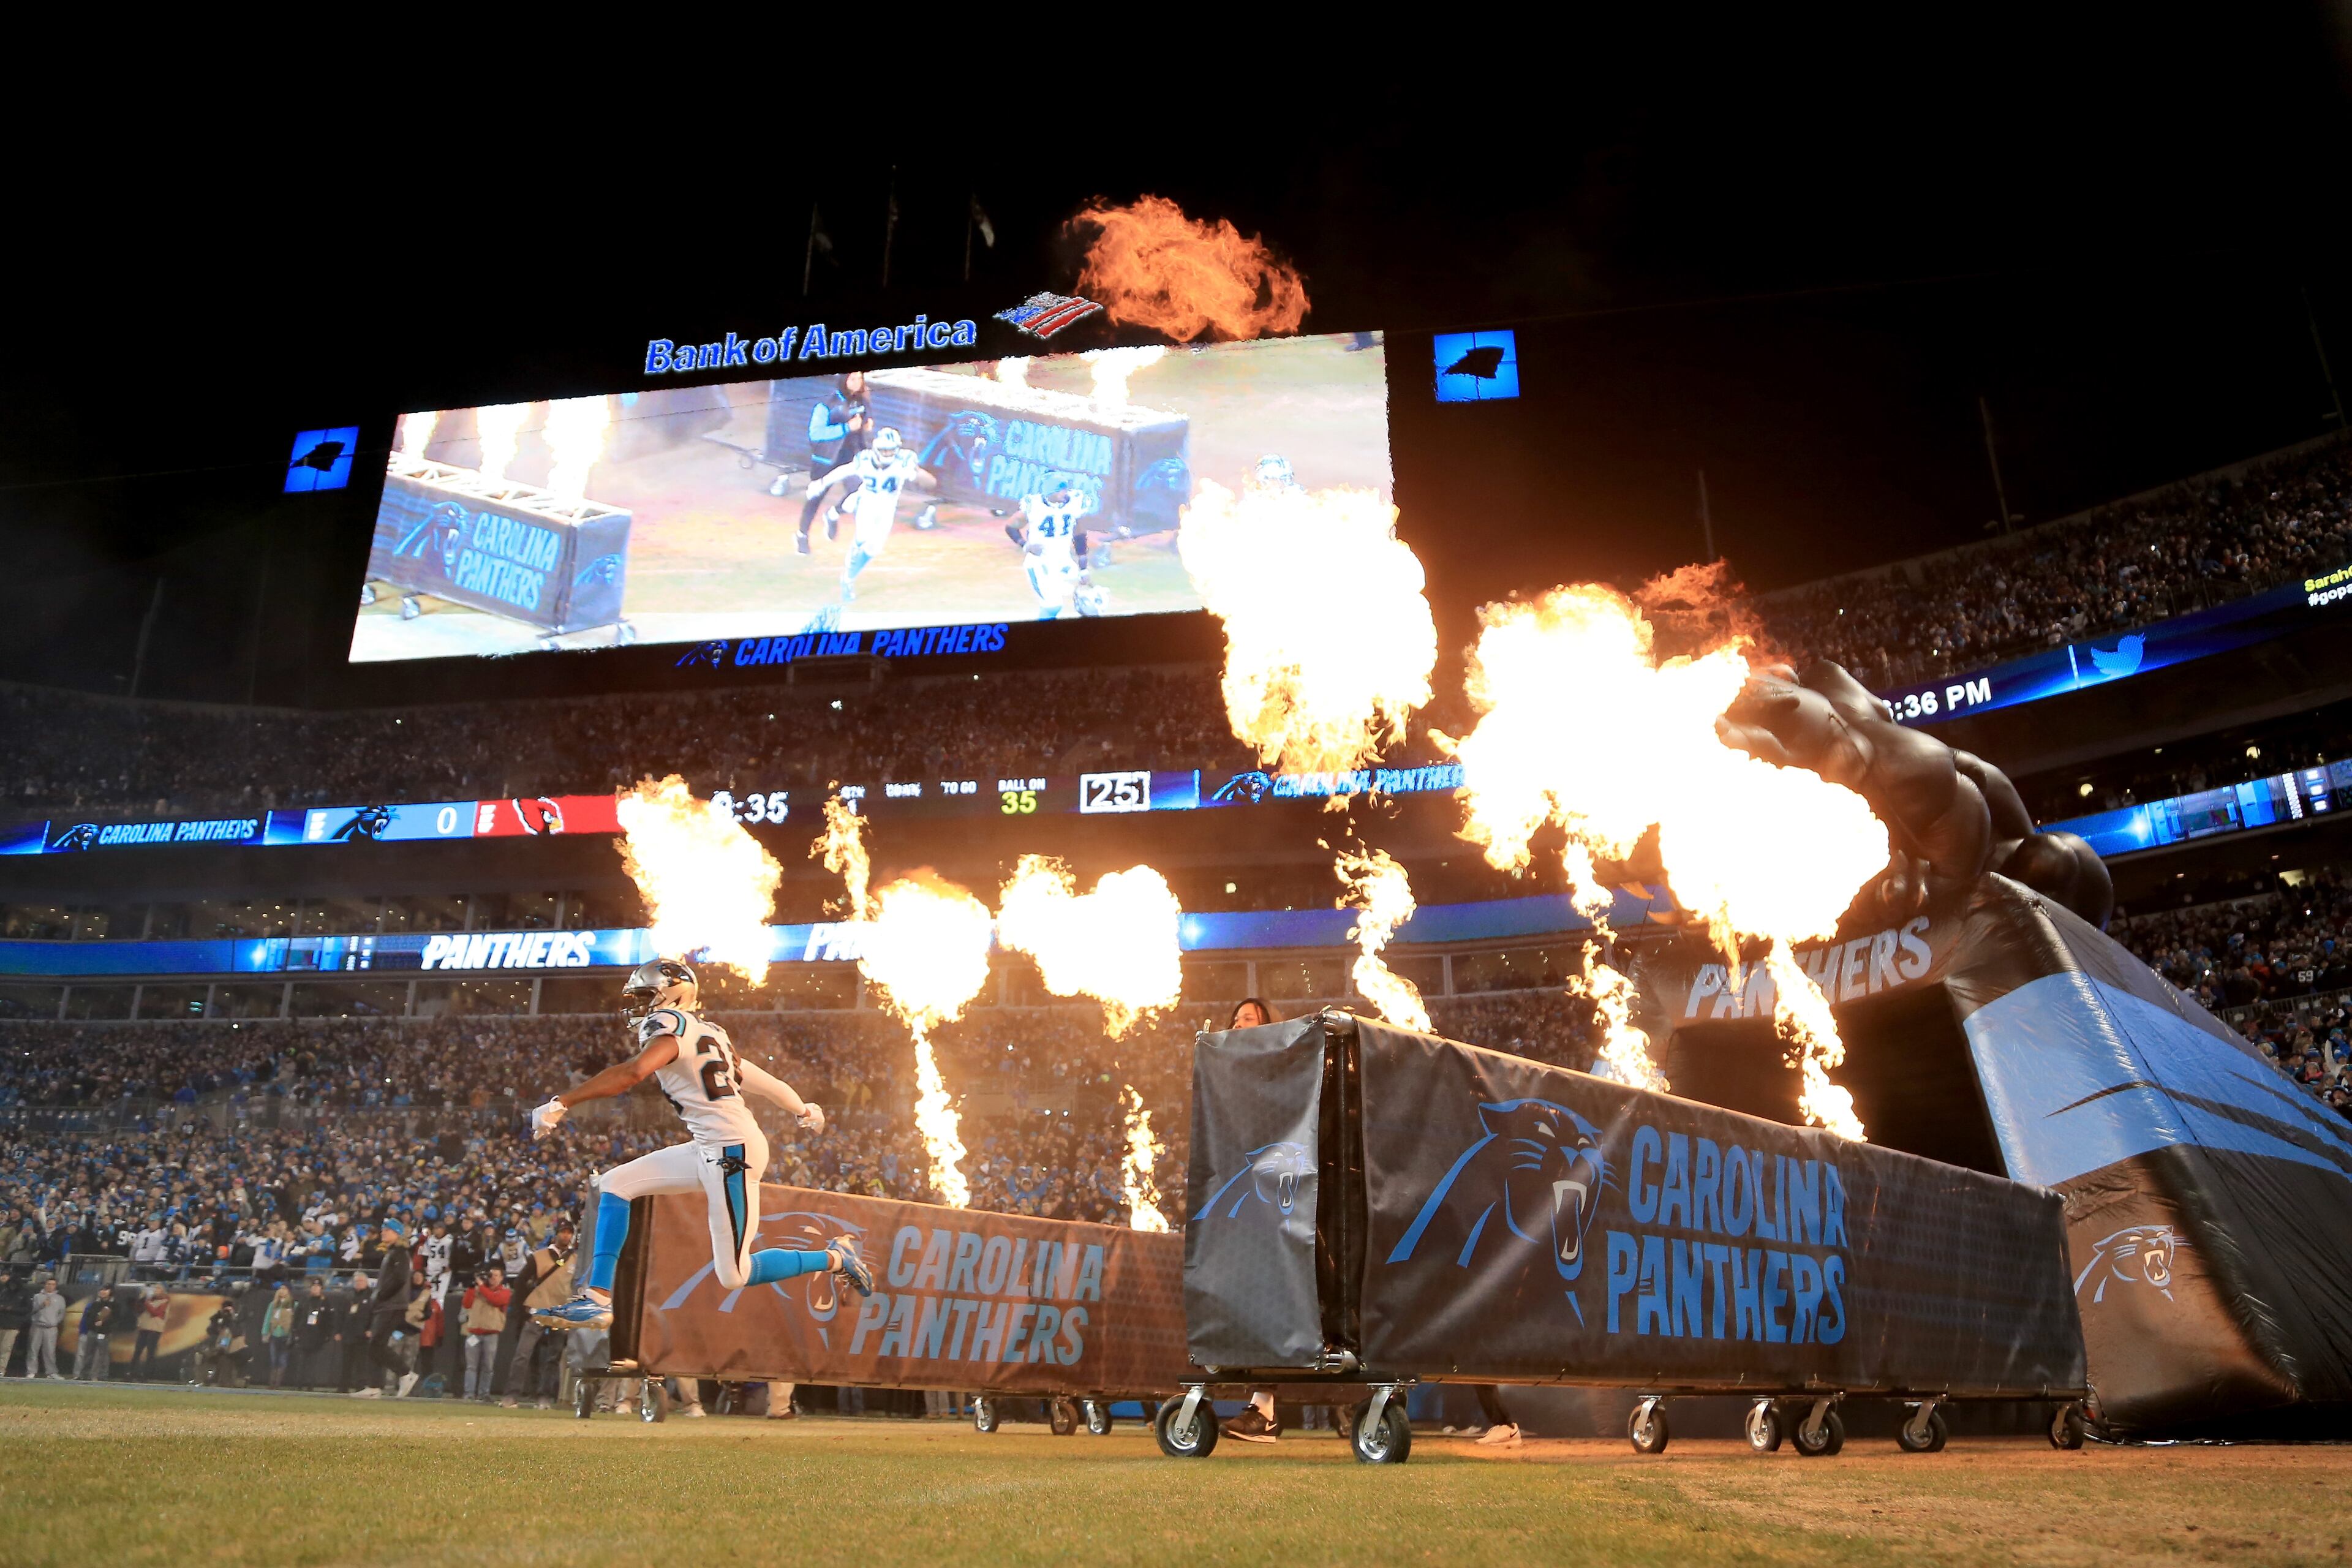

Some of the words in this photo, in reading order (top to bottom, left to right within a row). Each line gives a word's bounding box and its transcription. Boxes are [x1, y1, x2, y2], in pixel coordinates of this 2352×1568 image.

[644, 337, 748, 375] Bank
[752, 326, 799, 363] of
[798, 314, 977, 360] America
[1003, 419, 1112, 475] CAROLINA
[472, 511, 562, 573] CAROLINA
[1038, 514, 1072, 538] 41
[454, 548, 546, 611] PANTHERS
[735, 632, 862, 666] CAROLINA
[870, 623, 1009, 657] PANTHERS
[1945, 677, 1992, 711] PM
[940, 782, 957, 794] TO
[960, 781, 978, 794] GO
[998, 779, 1027, 793] BALL
[1029, 778, 1046, 791] ON
[1001, 791, 1038, 815] 35
[1090, 778, 1137, 807] 25
[98, 823, 176, 845] CAROLINA
[173, 819, 258, 841] PANTHERS
[436, 807, 458, 834] 0
[421, 931, 597, 970] PANTHERS
[1628, 1125, 1849, 1248] CAROLINA
[887, 1225, 1104, 1302] CAROLINA
[1607, 1229, 1846, 1345] PANTHERS
[848, 1292, 1090, 1366] PANTHERS
